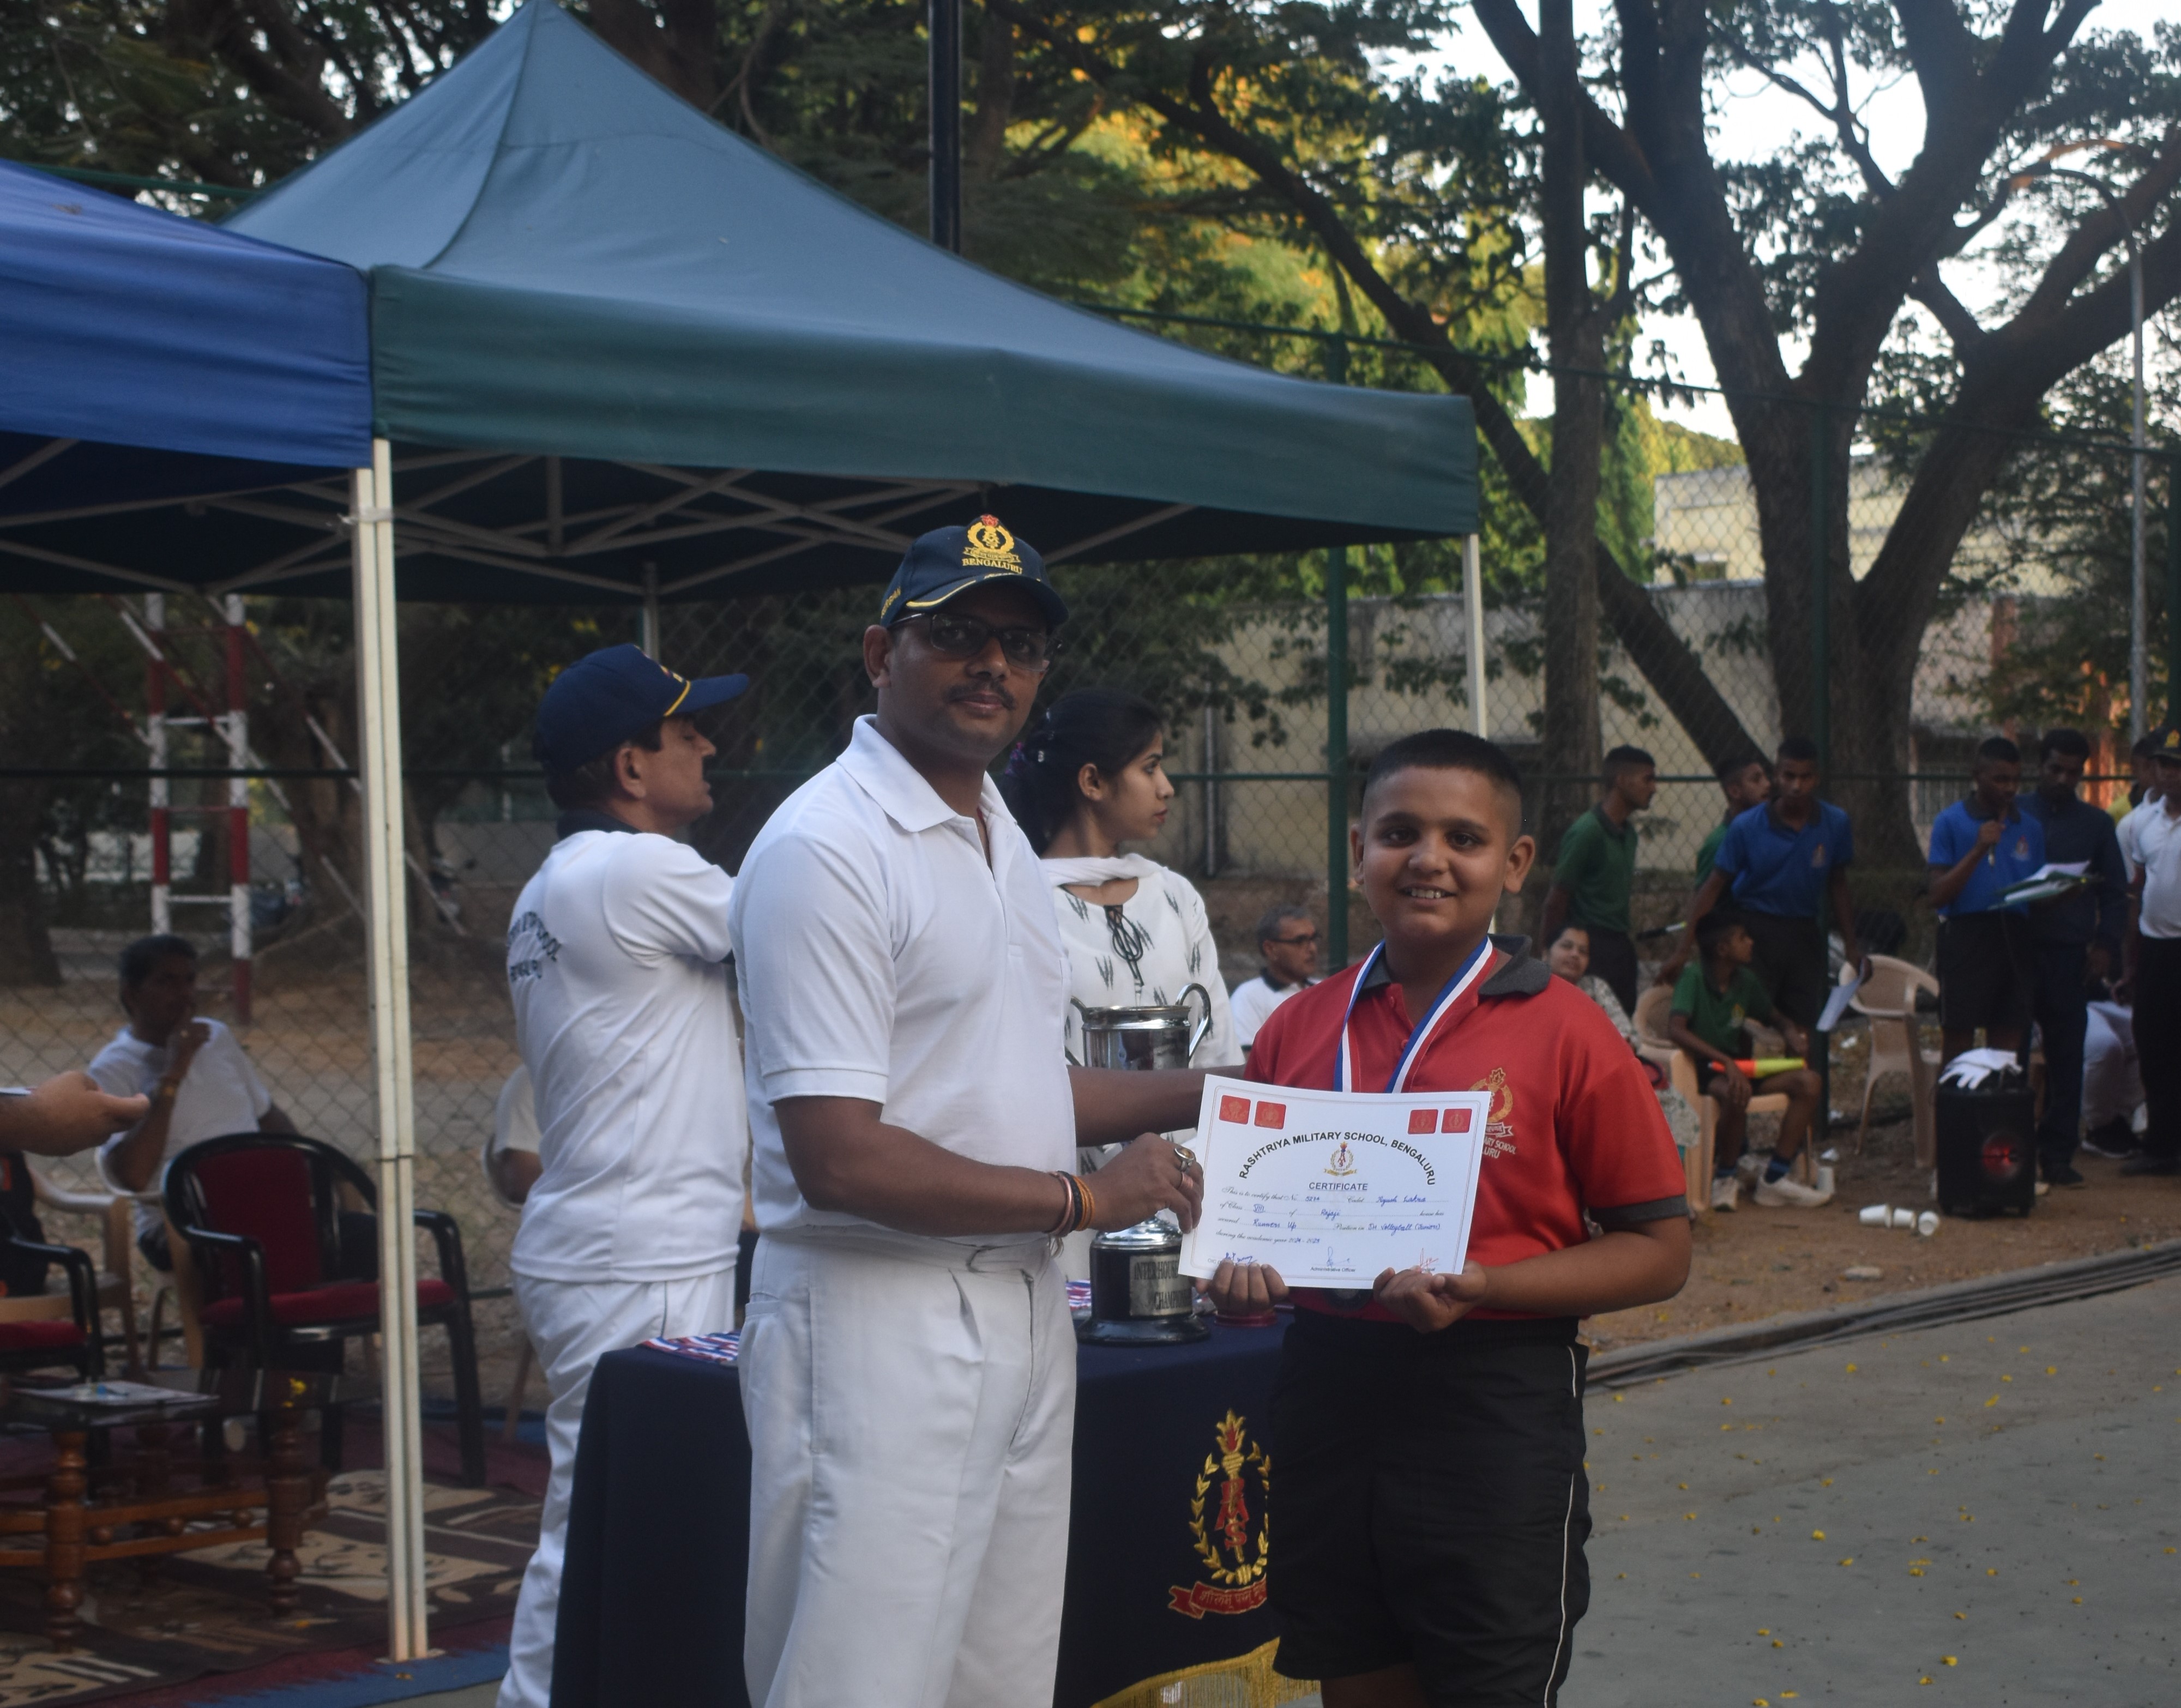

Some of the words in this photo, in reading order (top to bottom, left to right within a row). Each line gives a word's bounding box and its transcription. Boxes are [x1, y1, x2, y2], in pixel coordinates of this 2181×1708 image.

[962, 559, 1022, 574] BENGALURU
[1496, 1140, 1516, 1154] SCHOOL
[1239, 1138, 1291, 1179] RASHTRIYA
[1292, 1132, 1341, 1144] MILITARY
[1343, 1132, 1388, 1146] SCHOOL,
[1390, 1139, 1435, 1185] BENGALURU
[1222, 1186, 1237, 1195] This
[1251, 1192, 1269, 1200] certify
[1309, 1182, 1368, 1191] CERTIFICATE
[1220, 1201, 1227, 1209] of
[1228, 1201, 1243, 1210] Class
[1253, 1204, 1265, 1214] VIII
[1287, 1222, 1297, 1232] Up
[1215, 1230, 1236, 1239] during
[1246, 1234, 1273, 1242] academic
